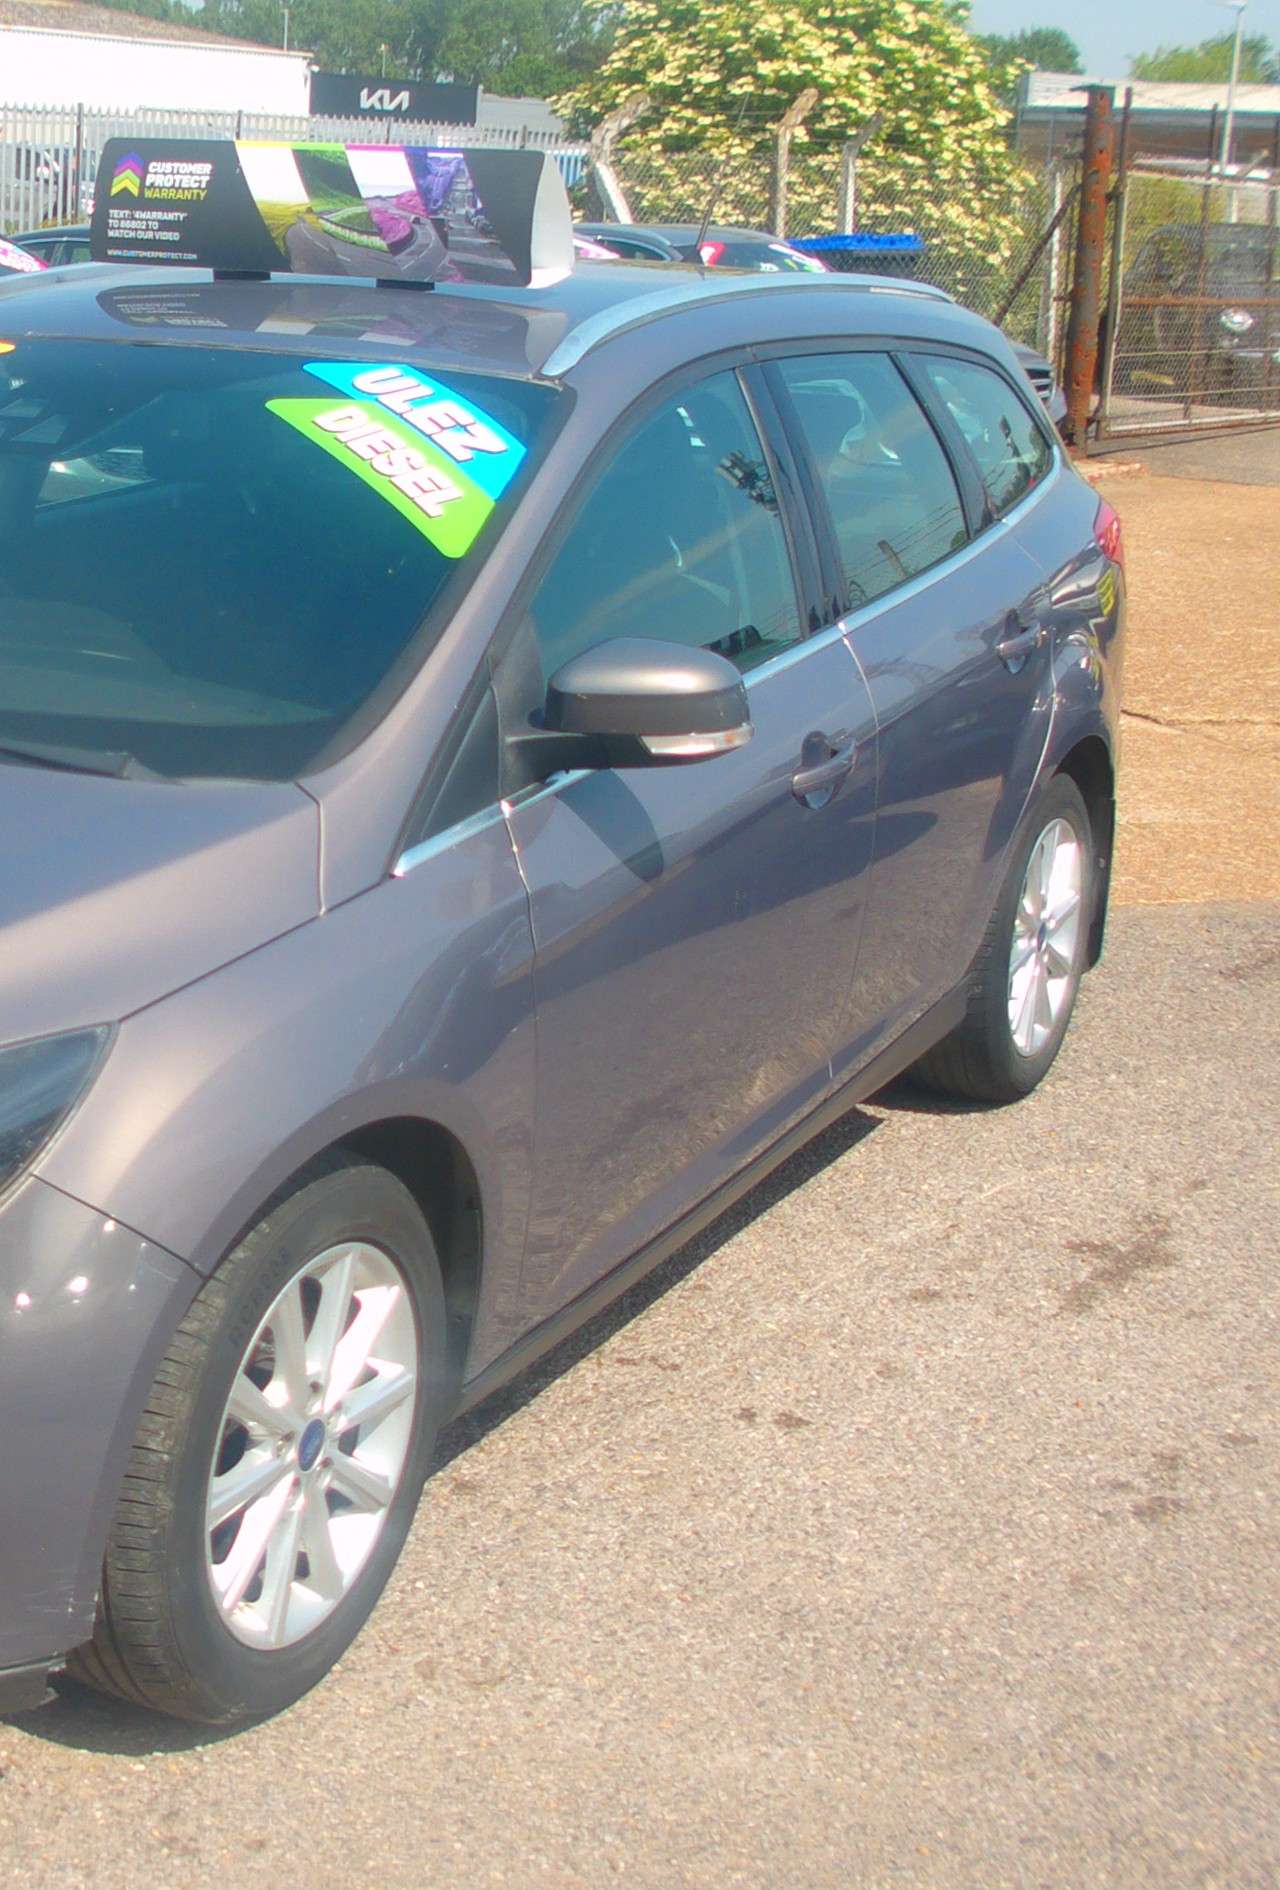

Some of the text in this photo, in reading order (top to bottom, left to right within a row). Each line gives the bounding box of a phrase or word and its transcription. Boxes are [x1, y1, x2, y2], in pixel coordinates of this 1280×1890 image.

[148, 161, 212, 175] CUSTOMER
[145, 174, 210, 188] PROTECT
[144, 188, 208, 200] WARRANTY
[108, 219, 119, 228] TO
[148, 221, 159, 229] TO
[107, 229, 180, 241] WATCH OUR VIDEO
[351, 367, 510, 464] ULEZ
[312, 405, 465, 519] DIESEL
